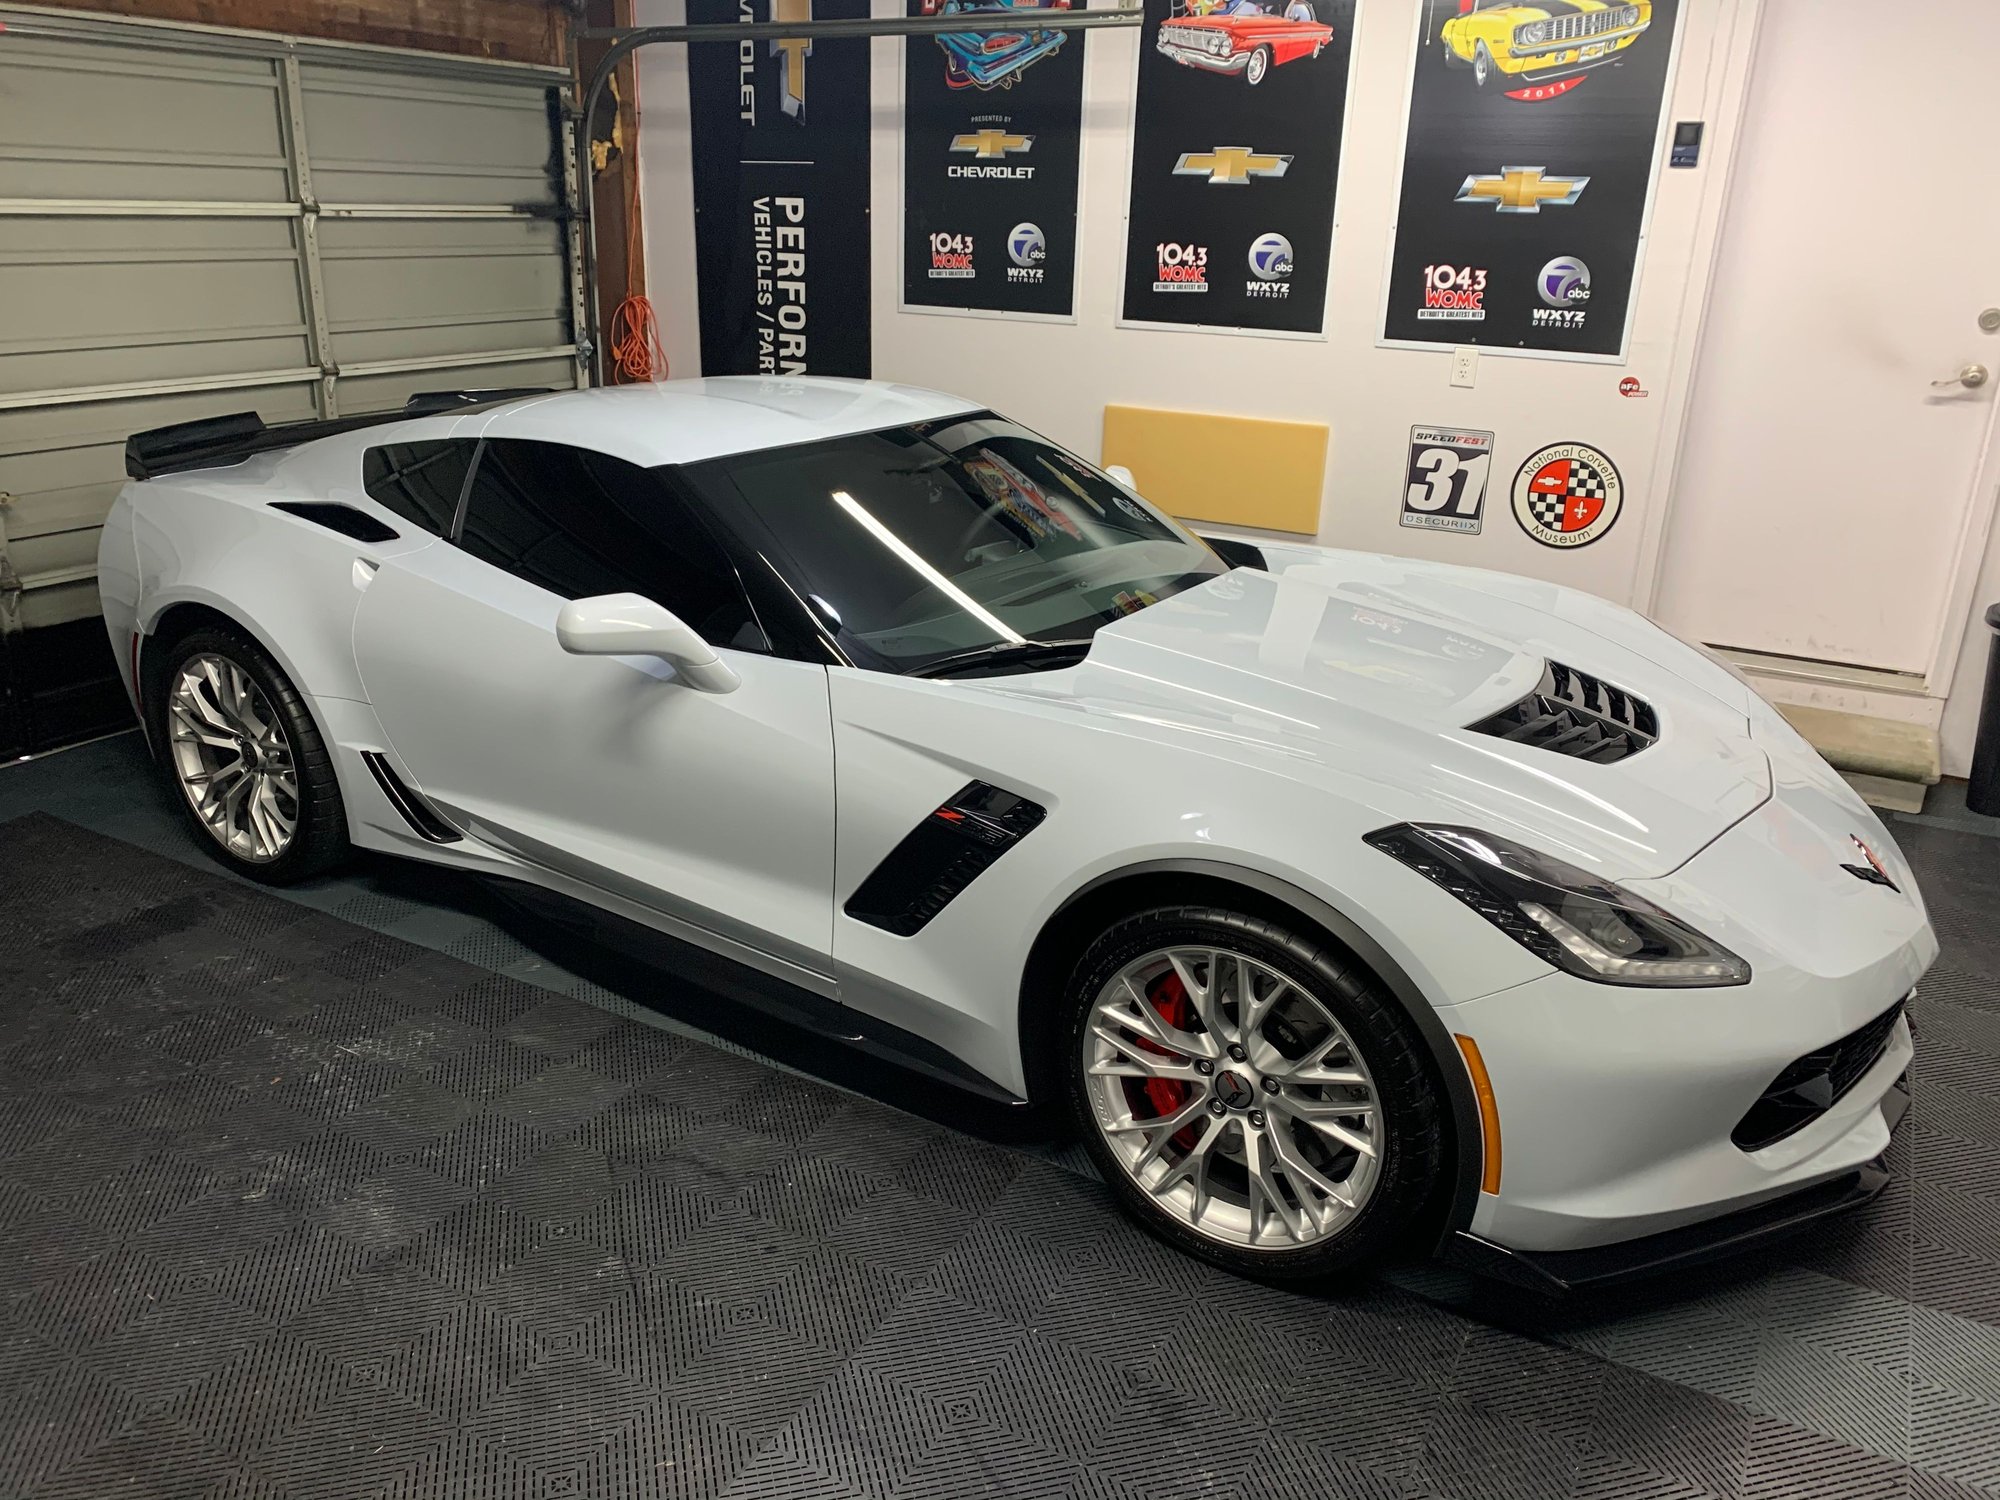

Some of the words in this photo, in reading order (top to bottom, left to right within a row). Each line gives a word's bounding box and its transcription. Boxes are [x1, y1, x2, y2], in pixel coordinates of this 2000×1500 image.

[1522, 82, 1566, 98] 2011
[971, 115, 1003, 123] PRESENTED
[947, 166, 1035, 179] CHEVROLET
[930, 232, 974, 254] 104.3
[753, 197, 773, 306] VEHICLES
[1030, 250, 1046, 259] abc
[1156, 243, 1208, 266] 104.3
[932, 253, 973, 269] WOMC
[1274, 262, 1293, 272] abc
[1007, 267, 1044, 278] WXYZ
[1158, 264, 1206, 282] WOMC
[1424, 264, 1488, 290] 104.3
[1246, 281, 1290, 293] WXYZ
[1567, 288, 1591, 299] abc
[1425, 288, 1484, 310] WOMC
[1420, 310, 1445, 318] DETROIT'S
[1471, 311, 1483, 319] HITS
[1532, 309, 1586, 322] WXYZ
[1532, 320, 1584, 329] DETROIT
[1620, 383, 1639, 391] aFe
[1415, 432, 1489, 446] SPEEDFEST
[1524, 447, 1574, 476] National
[1577, 448, 1616, 490] Corvette
[1407, 448, 1489, 515] 31
